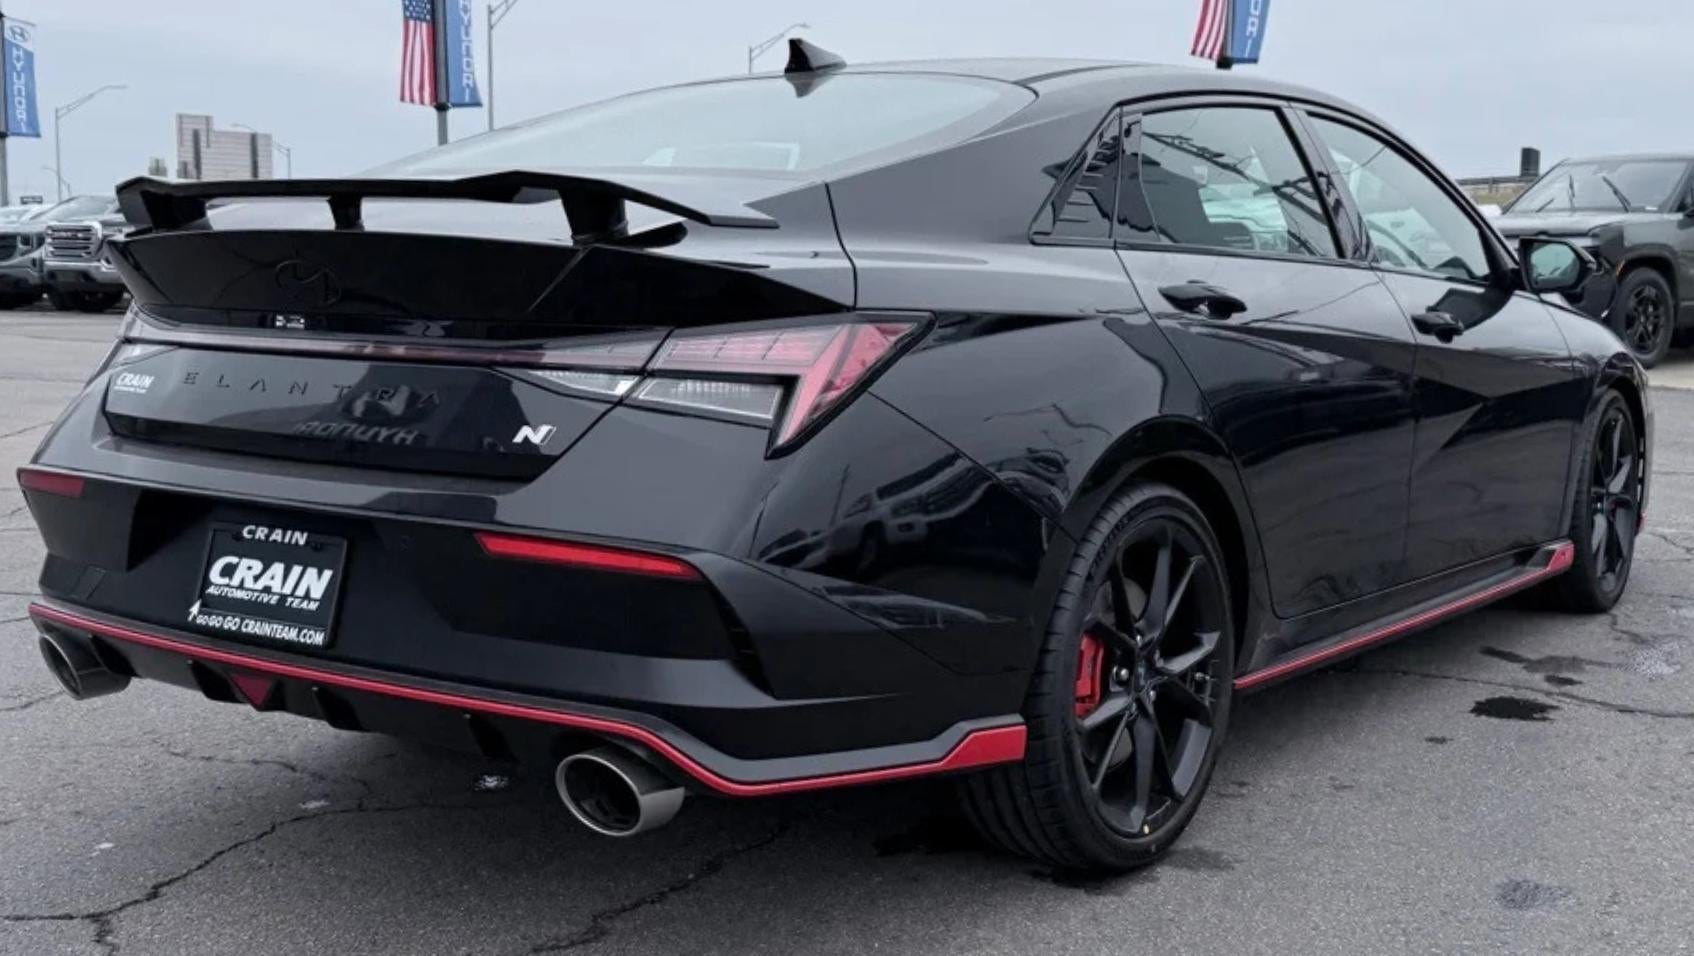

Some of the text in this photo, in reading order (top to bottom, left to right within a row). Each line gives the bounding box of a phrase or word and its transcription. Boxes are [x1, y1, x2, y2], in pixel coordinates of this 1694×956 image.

[12, 47, 27, 133] HYUNDAI
[183, 372, 440, 408] ELANTRA
[242, 525, 308, 545] CRAIN
[209, 555, 333, 600] CRAIN
[205, 585, 320, 611] AUTOMOTIVE TEAM
[241, 619, 325, 646] CRAINTEAM.COM
